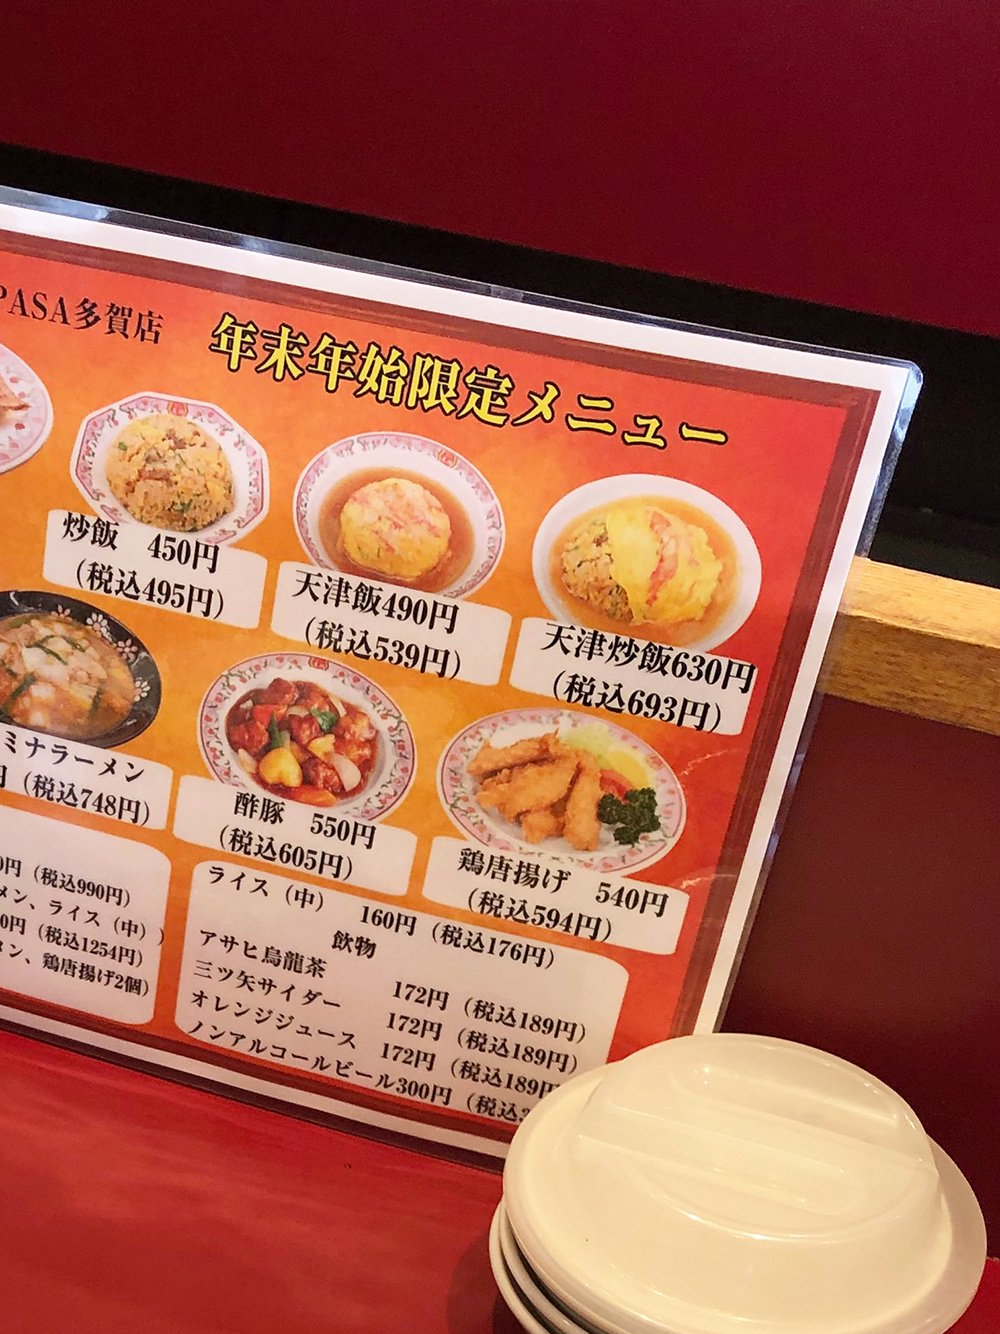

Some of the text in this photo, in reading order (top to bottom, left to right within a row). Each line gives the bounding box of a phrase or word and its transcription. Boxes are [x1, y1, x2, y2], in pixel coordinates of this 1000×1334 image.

[209, 312, 729, 449] 年末年始限定メニュー
[63, 512, 219, 572] 炒飯 450円
[76, 561, 225, 619] （税込495円）
[292, 570, 460, 635] 天津飯490円
[304, 617, 461, 680] （税込539円）
[541, 624, 756, 694] 天津炒飯630円
[552, 670, 723, 735] （税込693円）
[234, 792, 376, 850] 酢豚 550円
[219, 825, 354, 881] （税込605円）
[458, 847, 669, 919] 鶏唐揚げ 540円
[468, 887, 613, 943] （税込594円）
[198, 929, 327, 979] アサヒ烏龍茶
[332, 931, 376, 959] 飲物
[193, 961, 342, 1010] 三ツ矢サイダー
[191, 991, 356, 1049] オレンジジュース
